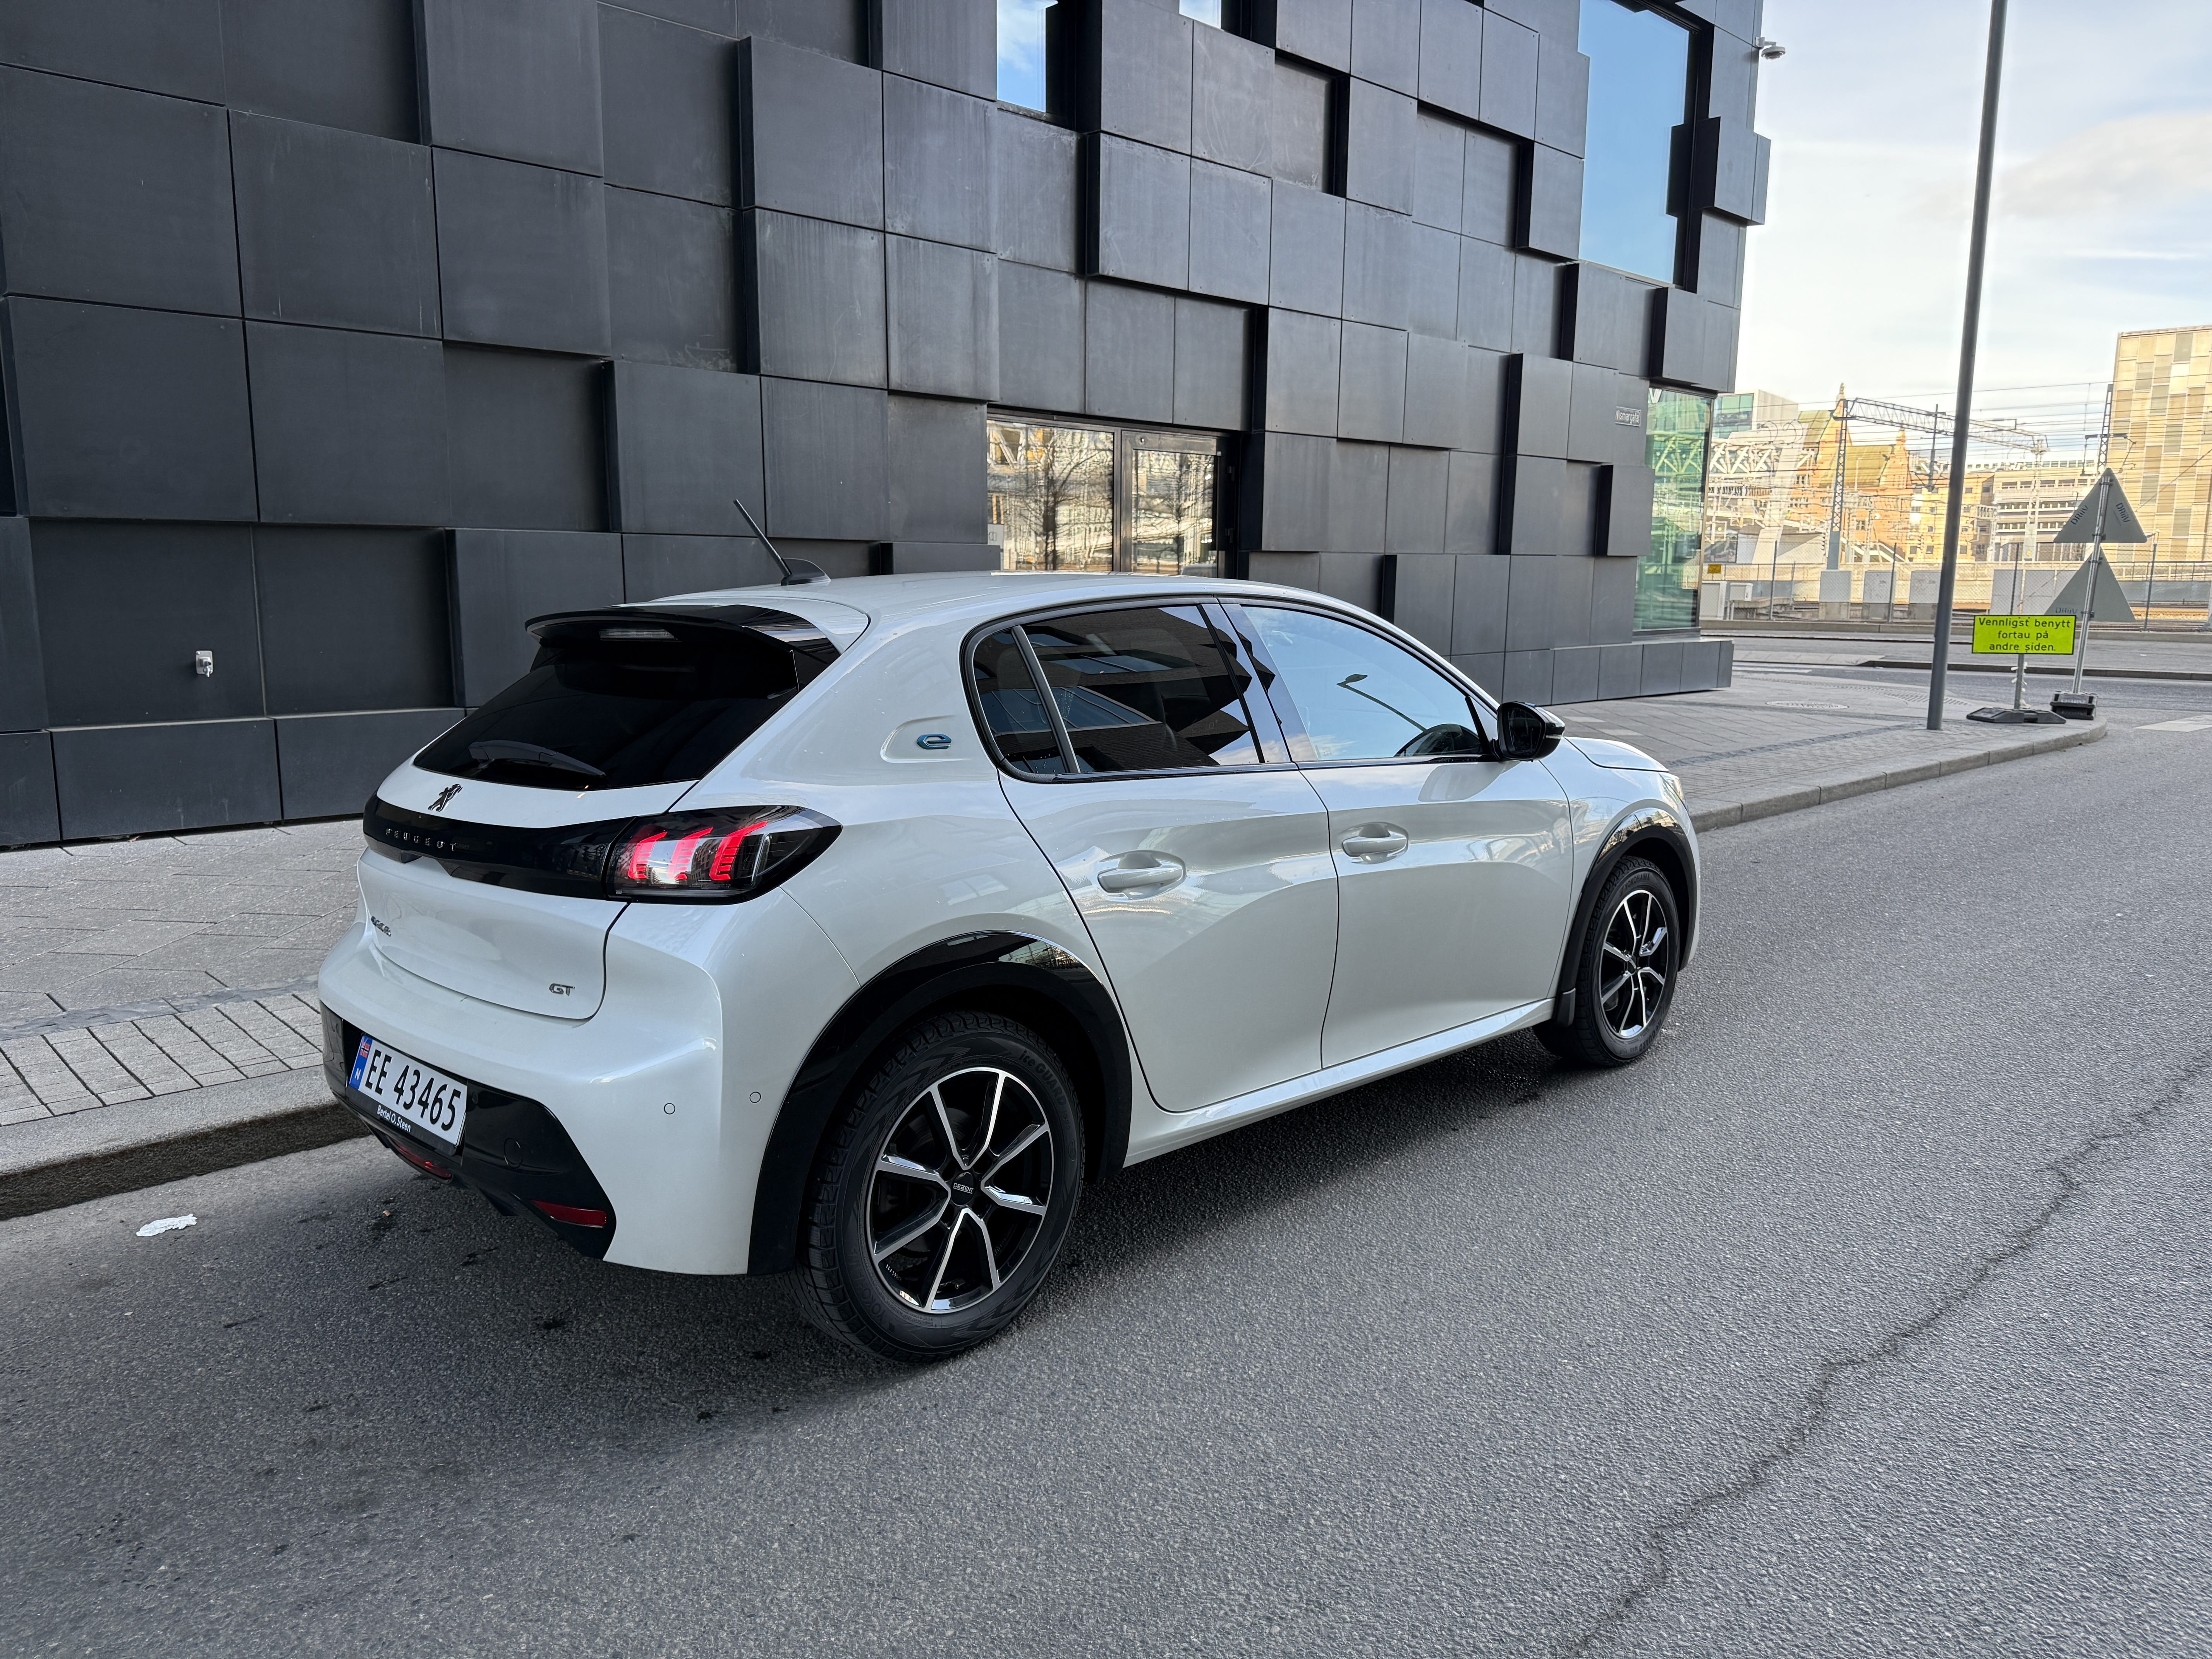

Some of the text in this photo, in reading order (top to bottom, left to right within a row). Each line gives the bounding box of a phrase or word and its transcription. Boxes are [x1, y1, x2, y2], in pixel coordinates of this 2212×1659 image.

[1979, 617, 2071, 629] Vennligst benytt
[1998, 630, 2049, 641] fortau på
[2025, 642, 2056, 651] siden.
[386, 828, 457, 851] PEUGEOT
[1625, 874, 1650, 890] YOKOHAMA
[549, 983, 575, 996] GT
[354, 1068, 361, 1080] N
[365, 1049, 461, 1131] EE 43465
[377, 1104, 411, 1133] Bertel O. Steen
[953, 1182, 974, 1192] DEZENT
